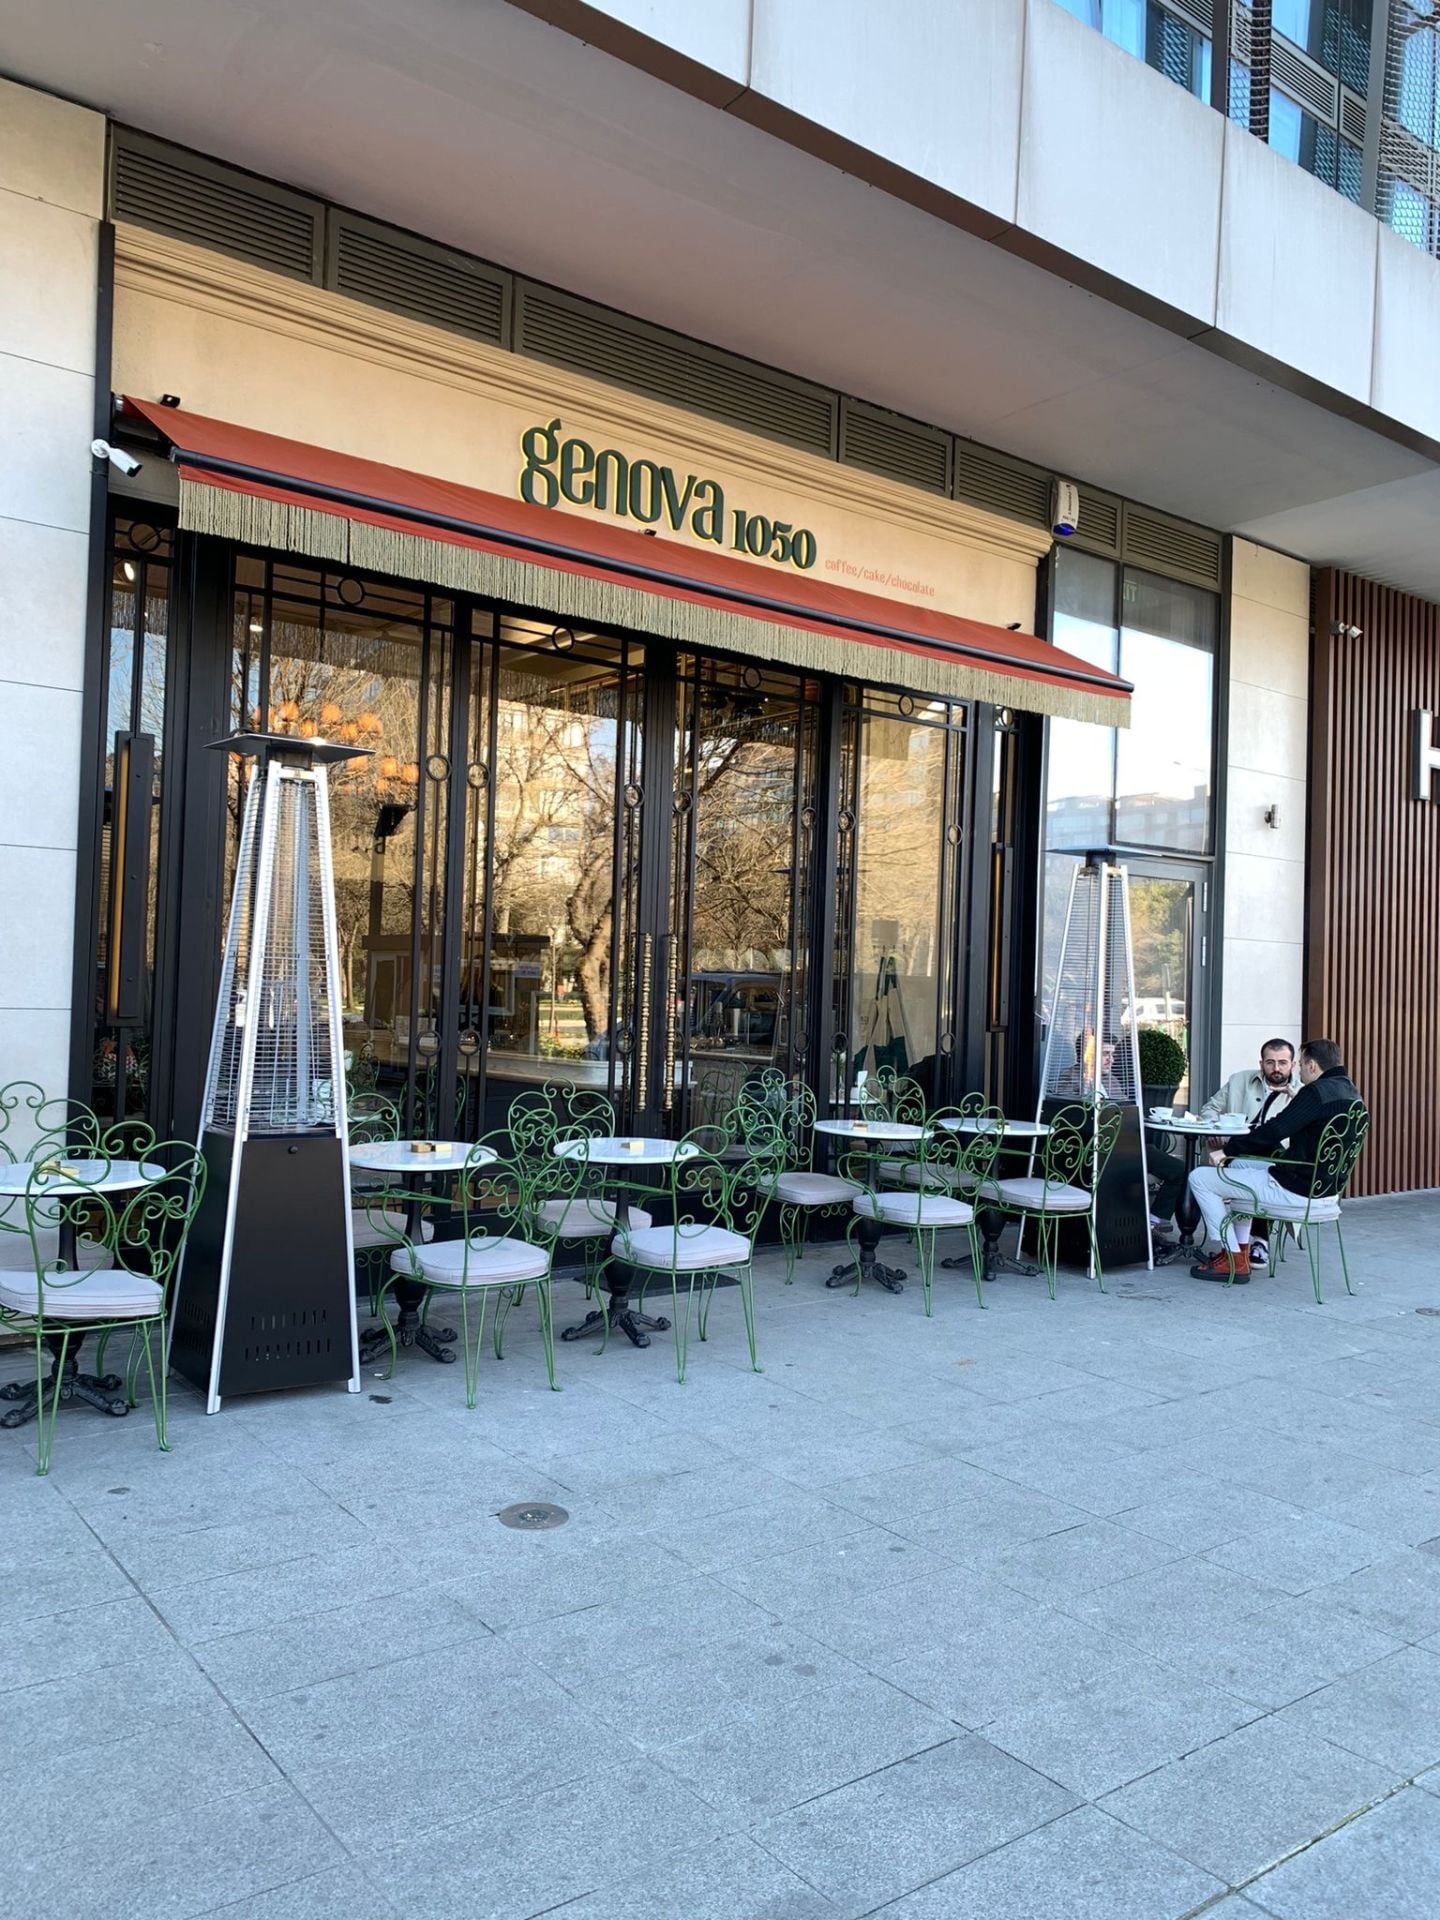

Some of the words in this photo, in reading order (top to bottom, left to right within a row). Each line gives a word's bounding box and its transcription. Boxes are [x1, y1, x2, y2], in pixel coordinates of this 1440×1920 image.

[520, 418, 725, 545] genova
[730, 509, 817, 570] 1050
[824, 559, 936, 597] coffee/cake/chocolate
